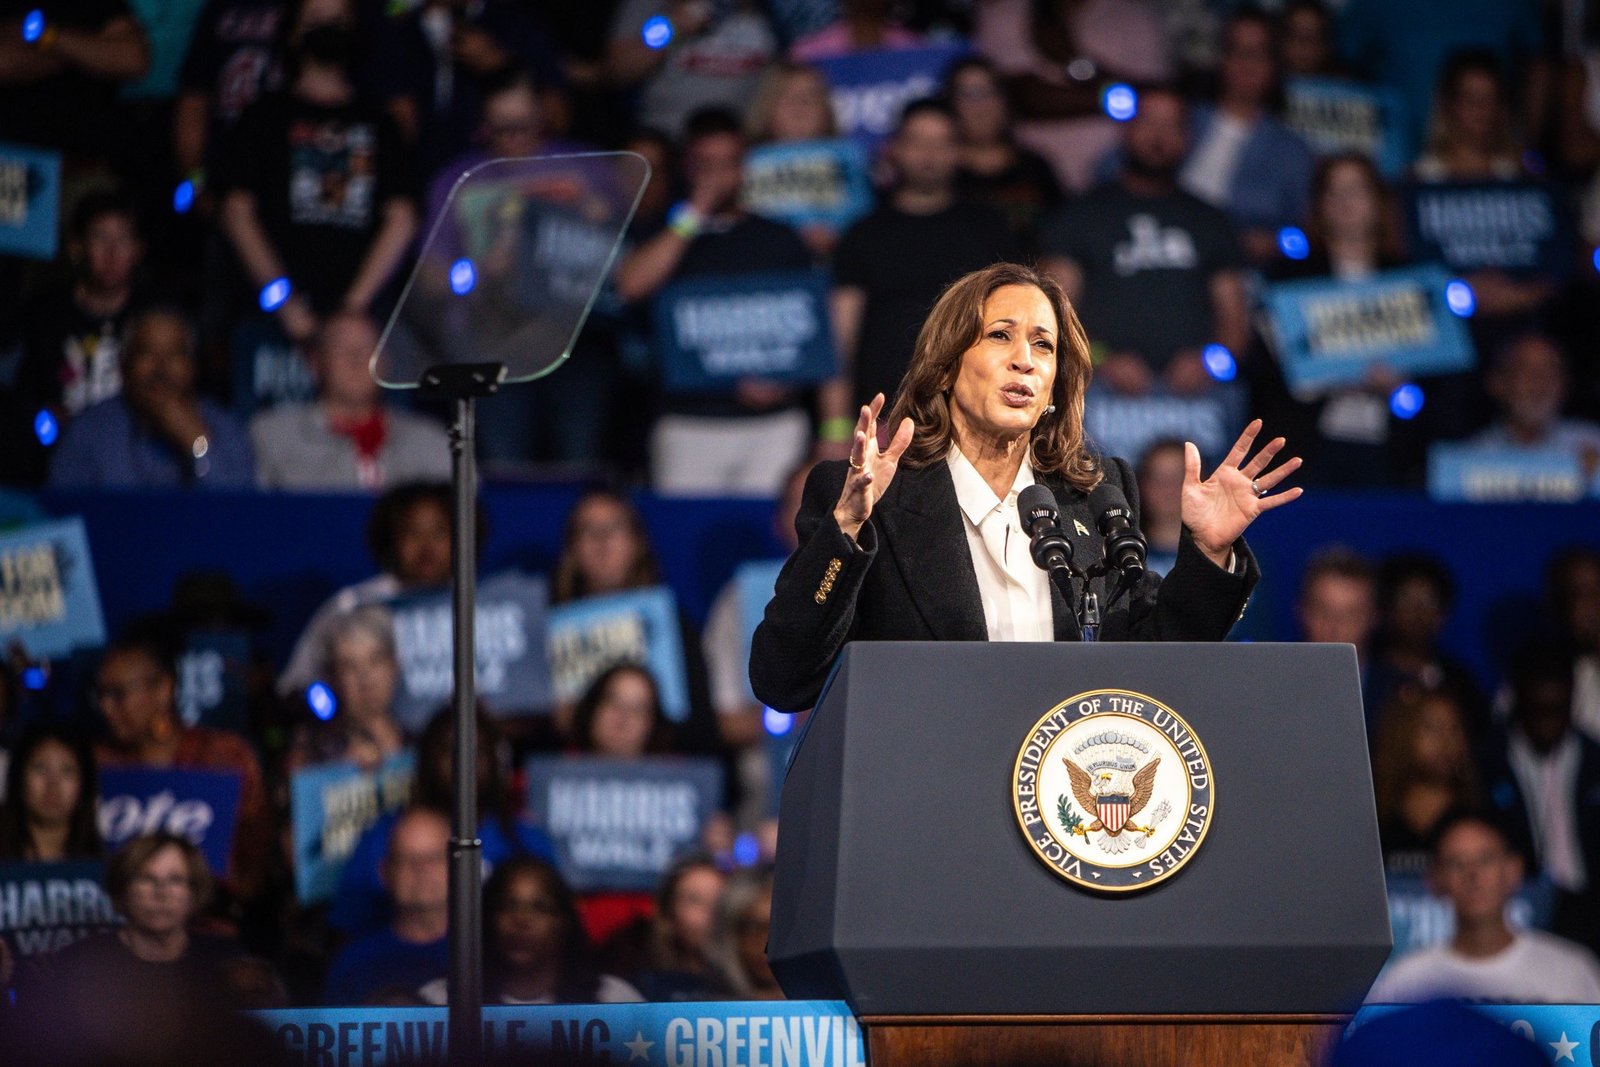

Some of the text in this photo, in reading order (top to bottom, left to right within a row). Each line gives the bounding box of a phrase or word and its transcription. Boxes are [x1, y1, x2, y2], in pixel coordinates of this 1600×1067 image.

[393, 602, 526, 660] HARIS
[1019, 697, 1209, 879] VICE PRESIDENT OF THE UNITED STATES
[96, 792, 214, 843] ote
